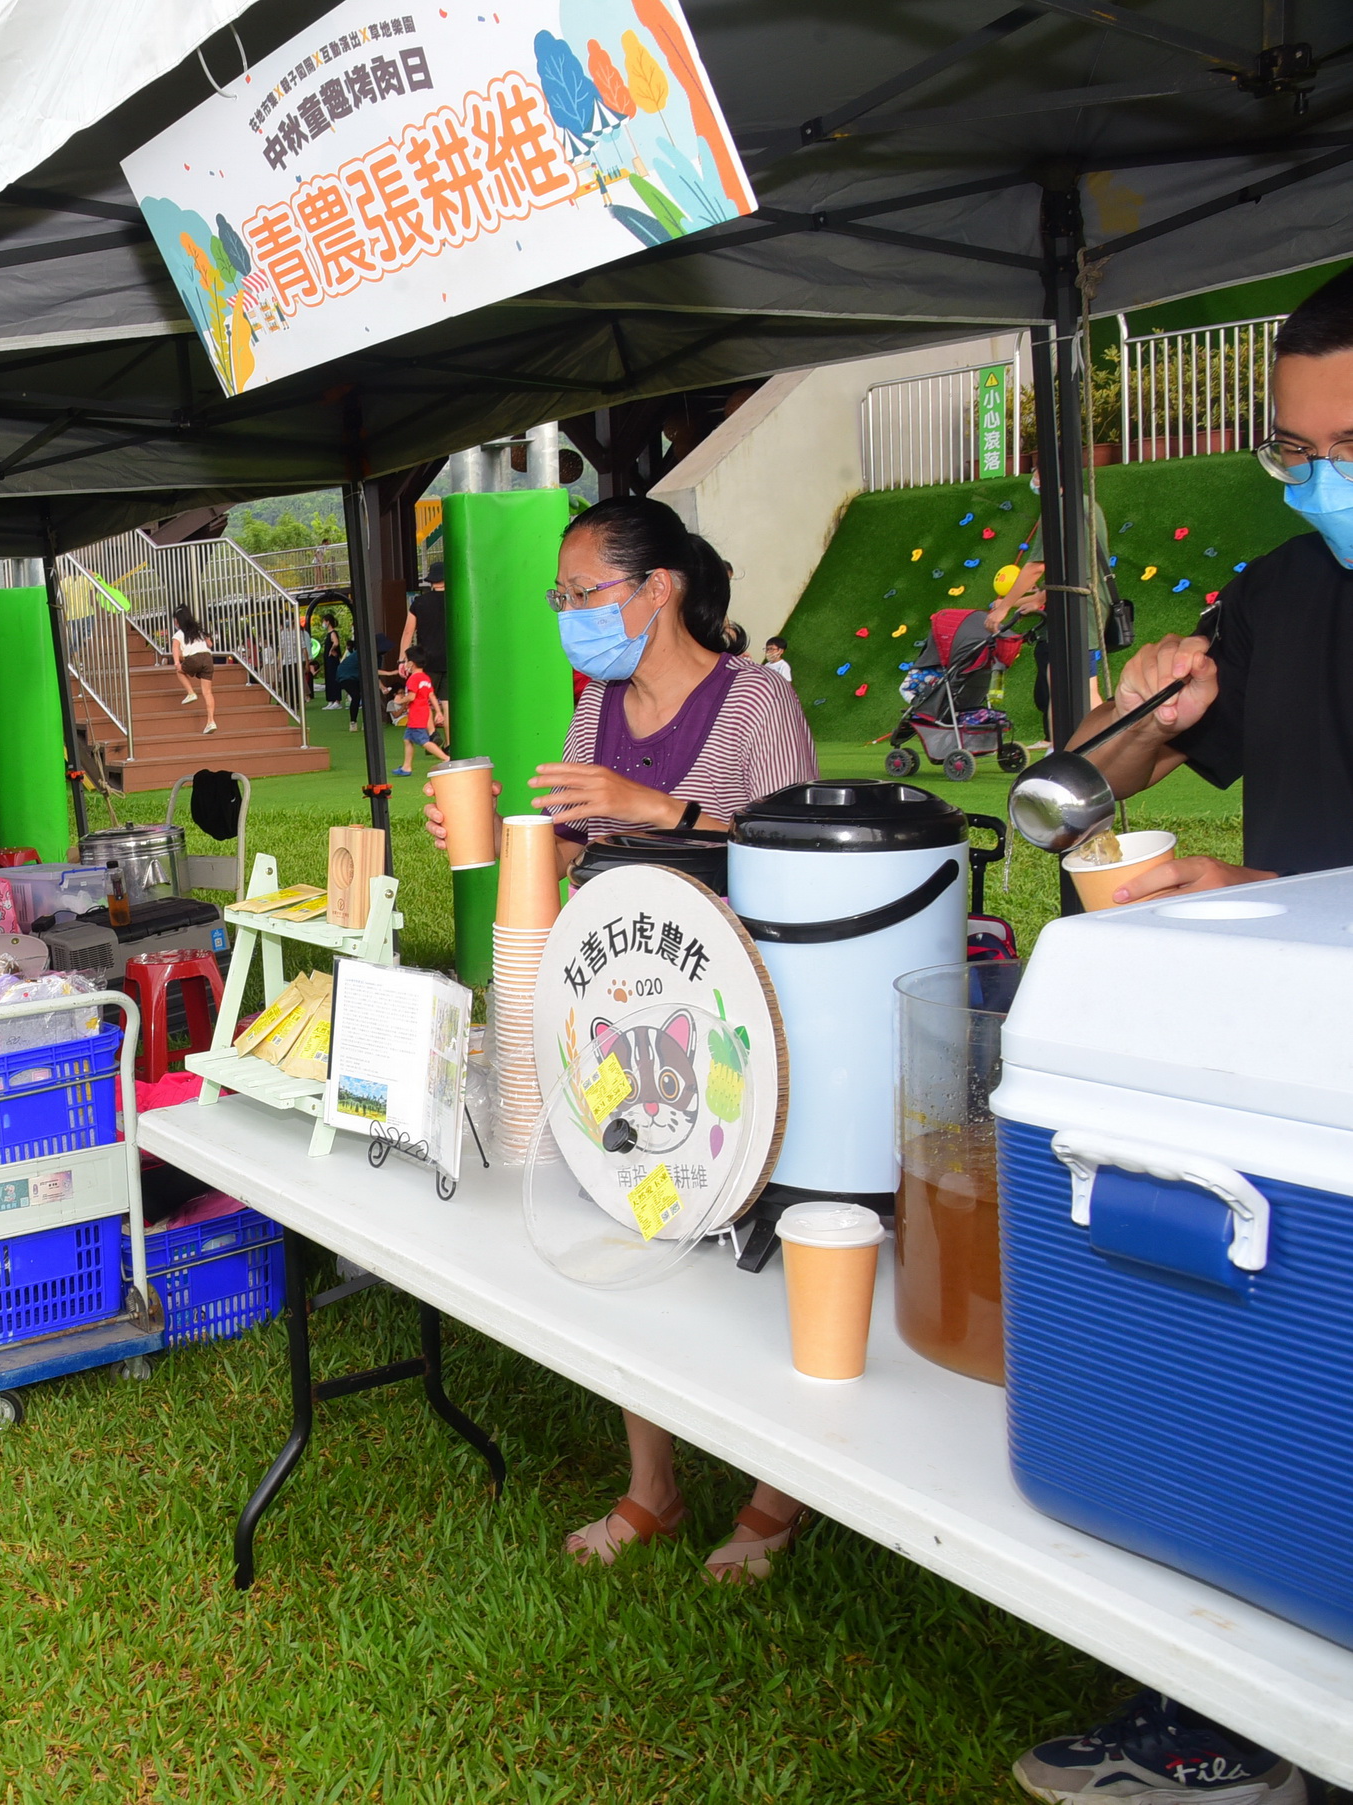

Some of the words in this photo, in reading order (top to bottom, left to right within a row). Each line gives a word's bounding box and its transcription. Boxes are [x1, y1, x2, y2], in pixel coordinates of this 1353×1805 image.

[263, 46, 434, 171] 中秋童趣烤肉日
[252, 84, 570, 304] 青農張耕維
[983, 389, 1001, 471] 小心滾落
[563, 911, 711, 1000] 友善石虎農作
[635, 977, 663, 997] 020
